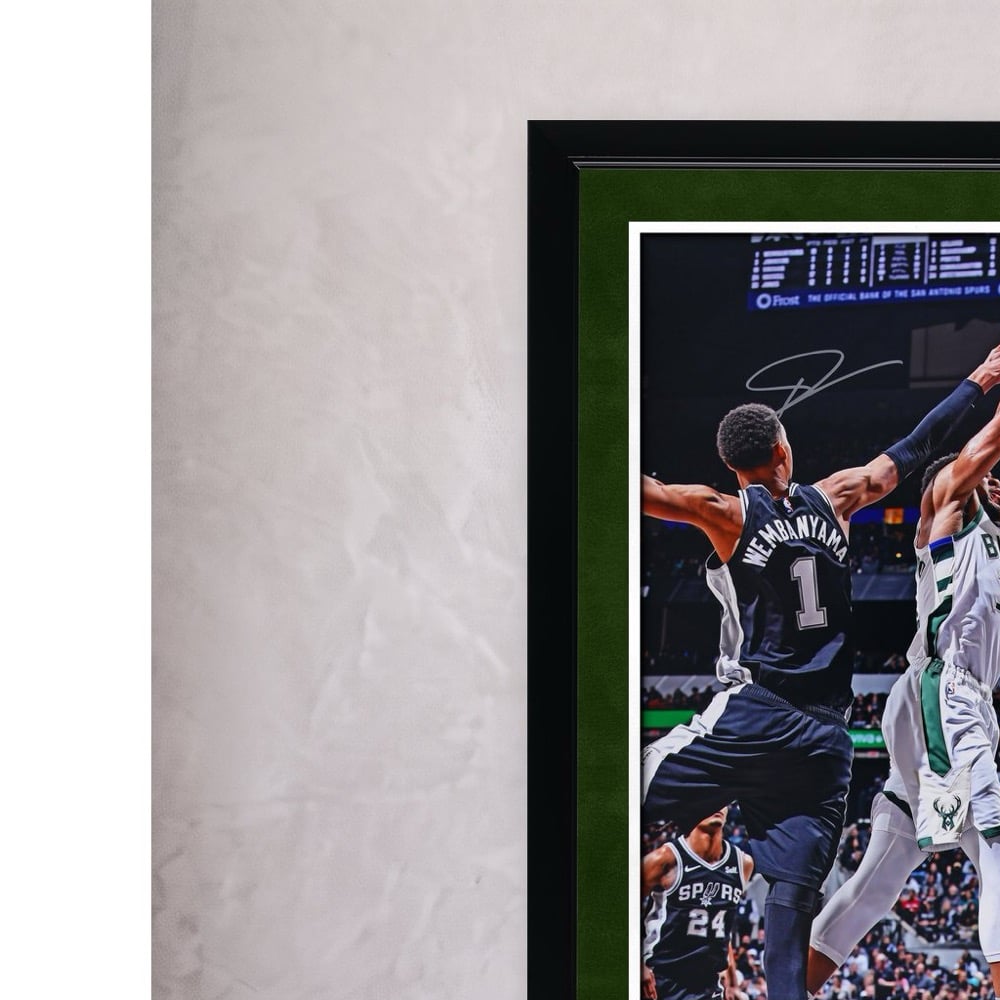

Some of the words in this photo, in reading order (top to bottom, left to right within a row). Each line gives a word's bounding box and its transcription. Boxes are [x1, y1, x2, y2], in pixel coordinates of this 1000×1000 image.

[773, 295, 799, 306] Frost
[965, 285, 990, 294] SPURS
[742, 515, 848, 568] WEMBANYAMA
[790, 556, 828, 631] 1
[687, 909, 727, 938] 24
